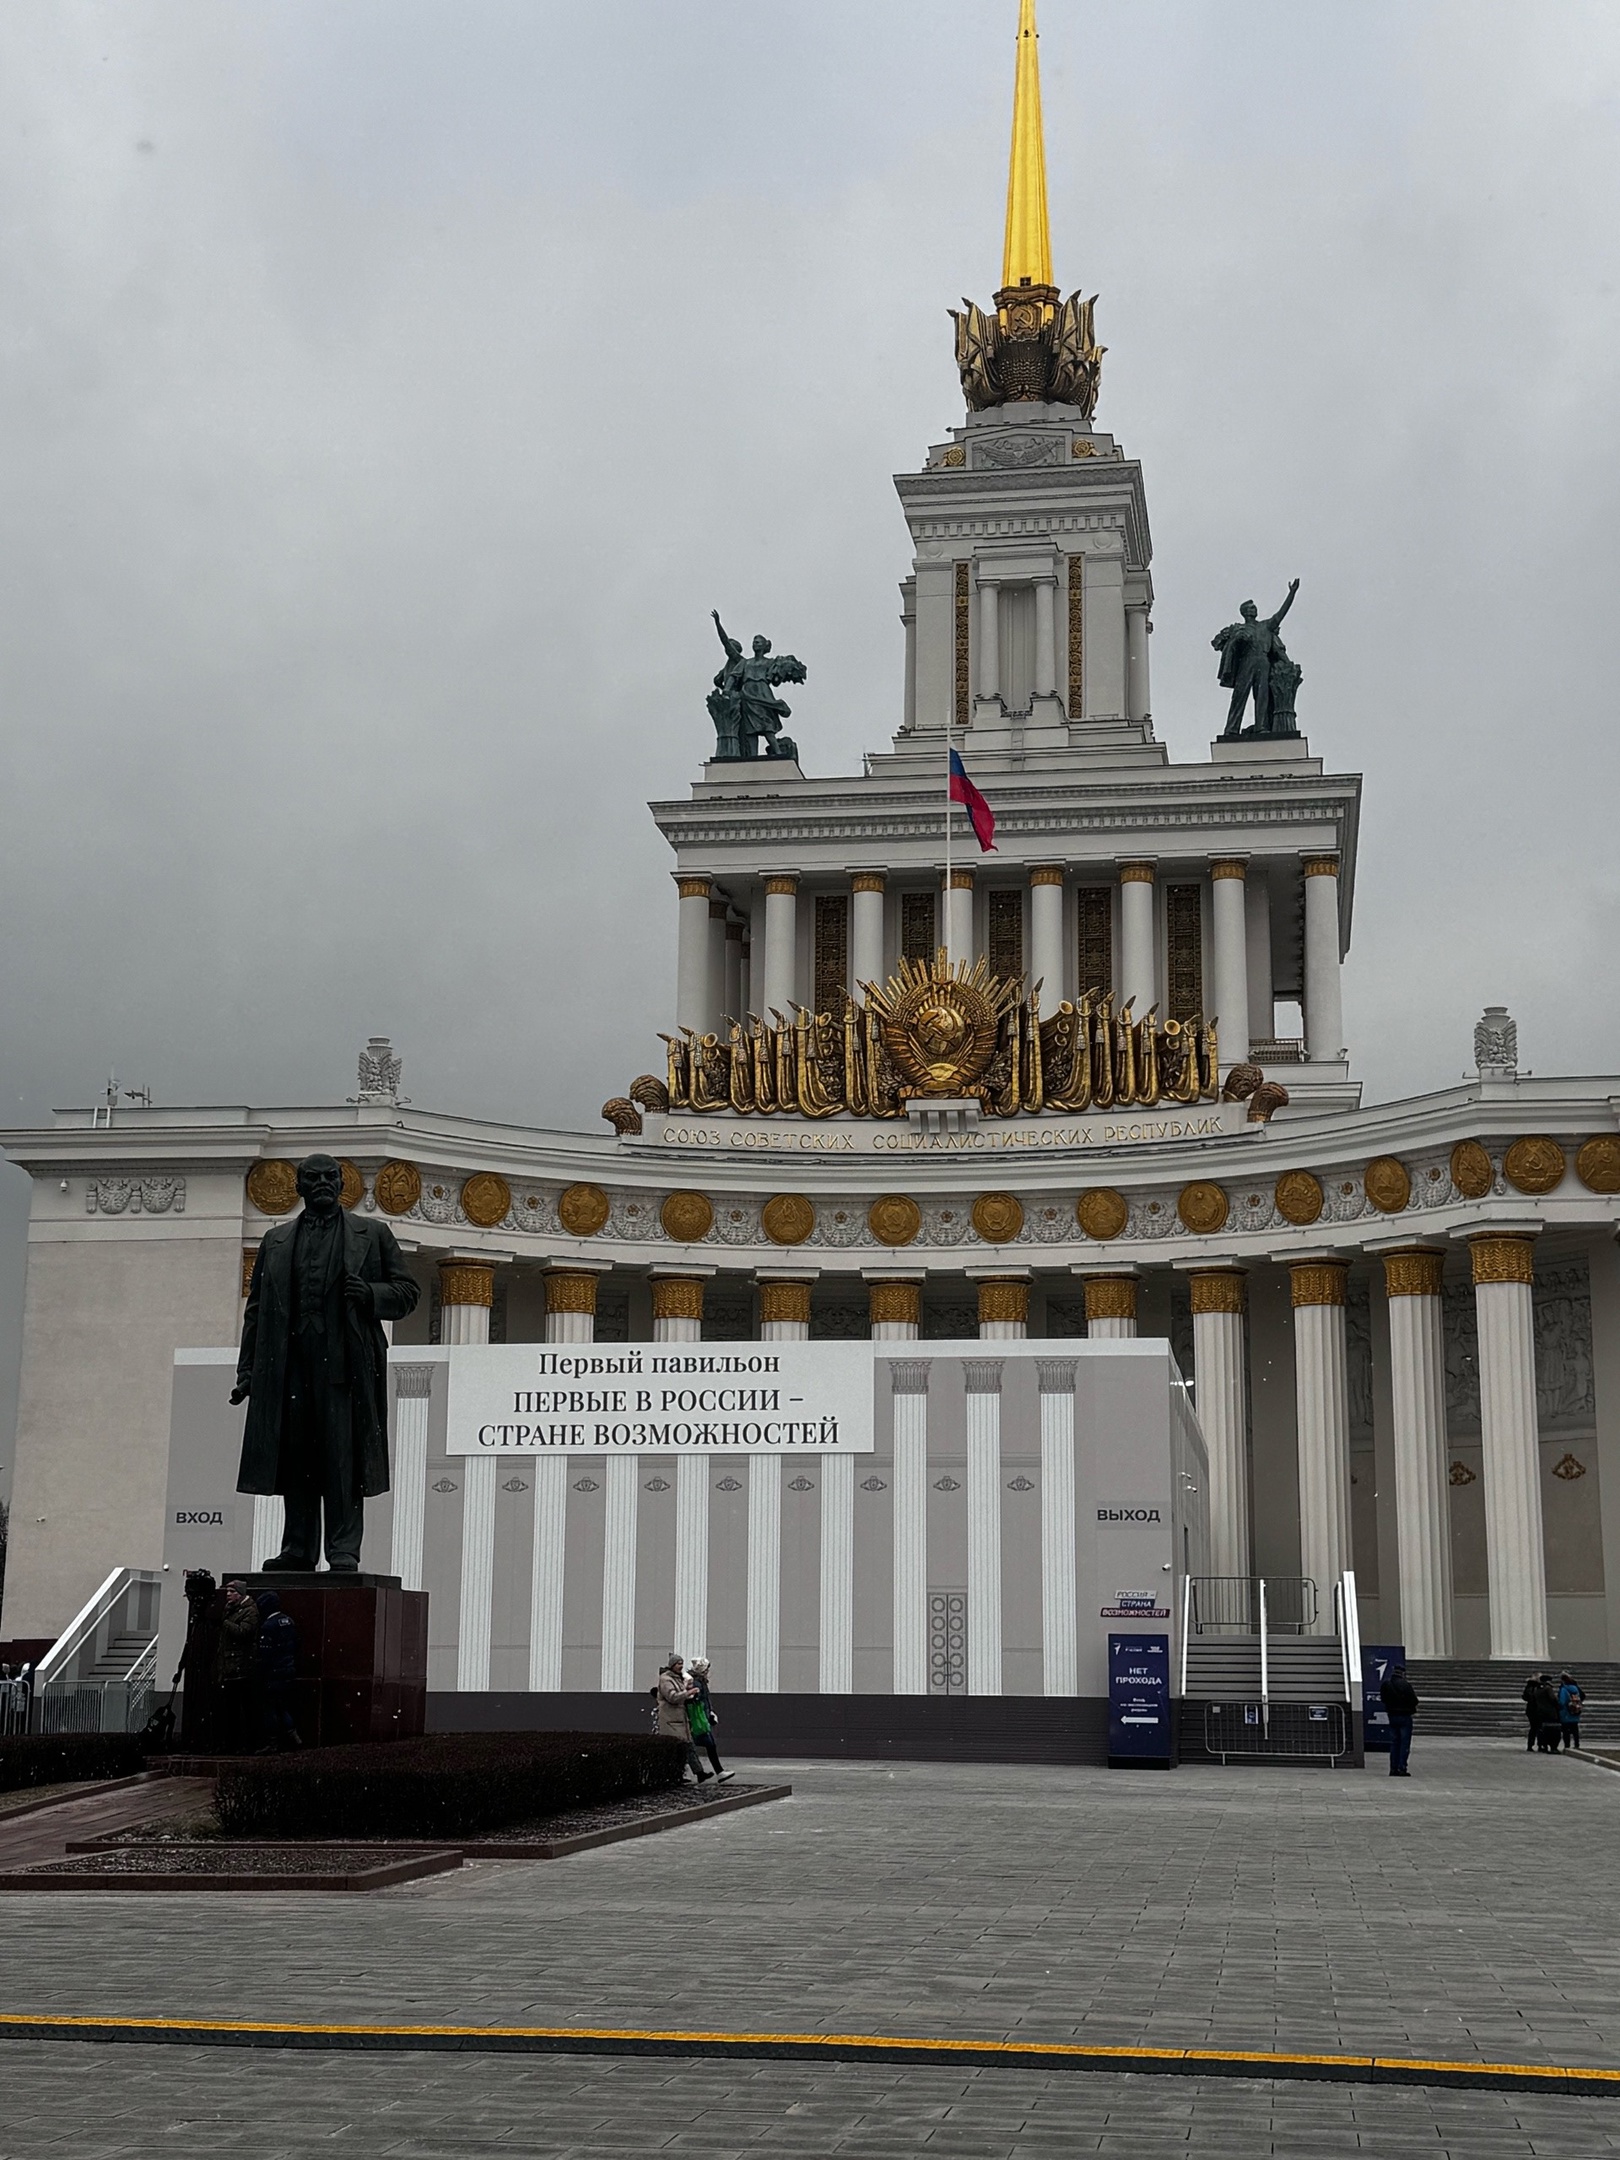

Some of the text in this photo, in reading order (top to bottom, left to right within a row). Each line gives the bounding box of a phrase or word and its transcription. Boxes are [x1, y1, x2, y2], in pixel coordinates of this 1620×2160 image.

[663, 1116, 1224, 1150] СОЮЗ СОВЕТСКИХ СОЦИАЛИСТИЧЕСКИХ РЕСПУБЛИК
[539, 1351, 780, 1379] Первый павильон
[513, 1390, 627, 1413] ПЕРВЫЕ
[636, 1391, 652, 1412] В
[660, 1388, 781, 1412] РОССИИ
[478, 1415, 839, 1447] СТРАНЕ ВОЗМОЖНОСТЕЙ
[176, 1511, 223, 1525] ВХОД
[1097, 1509, 1161, 1523] ВЫХОД
[1121, 1600, 1151, 1608] СТРАНА
[1102, 1608, 1167, 1617] ВОЗМОЖНОСТЕЙ
[1129, 1667, 1148, 1675] НЕТ
[1115, 1676, 1162, 1685] ПРОХОДА
